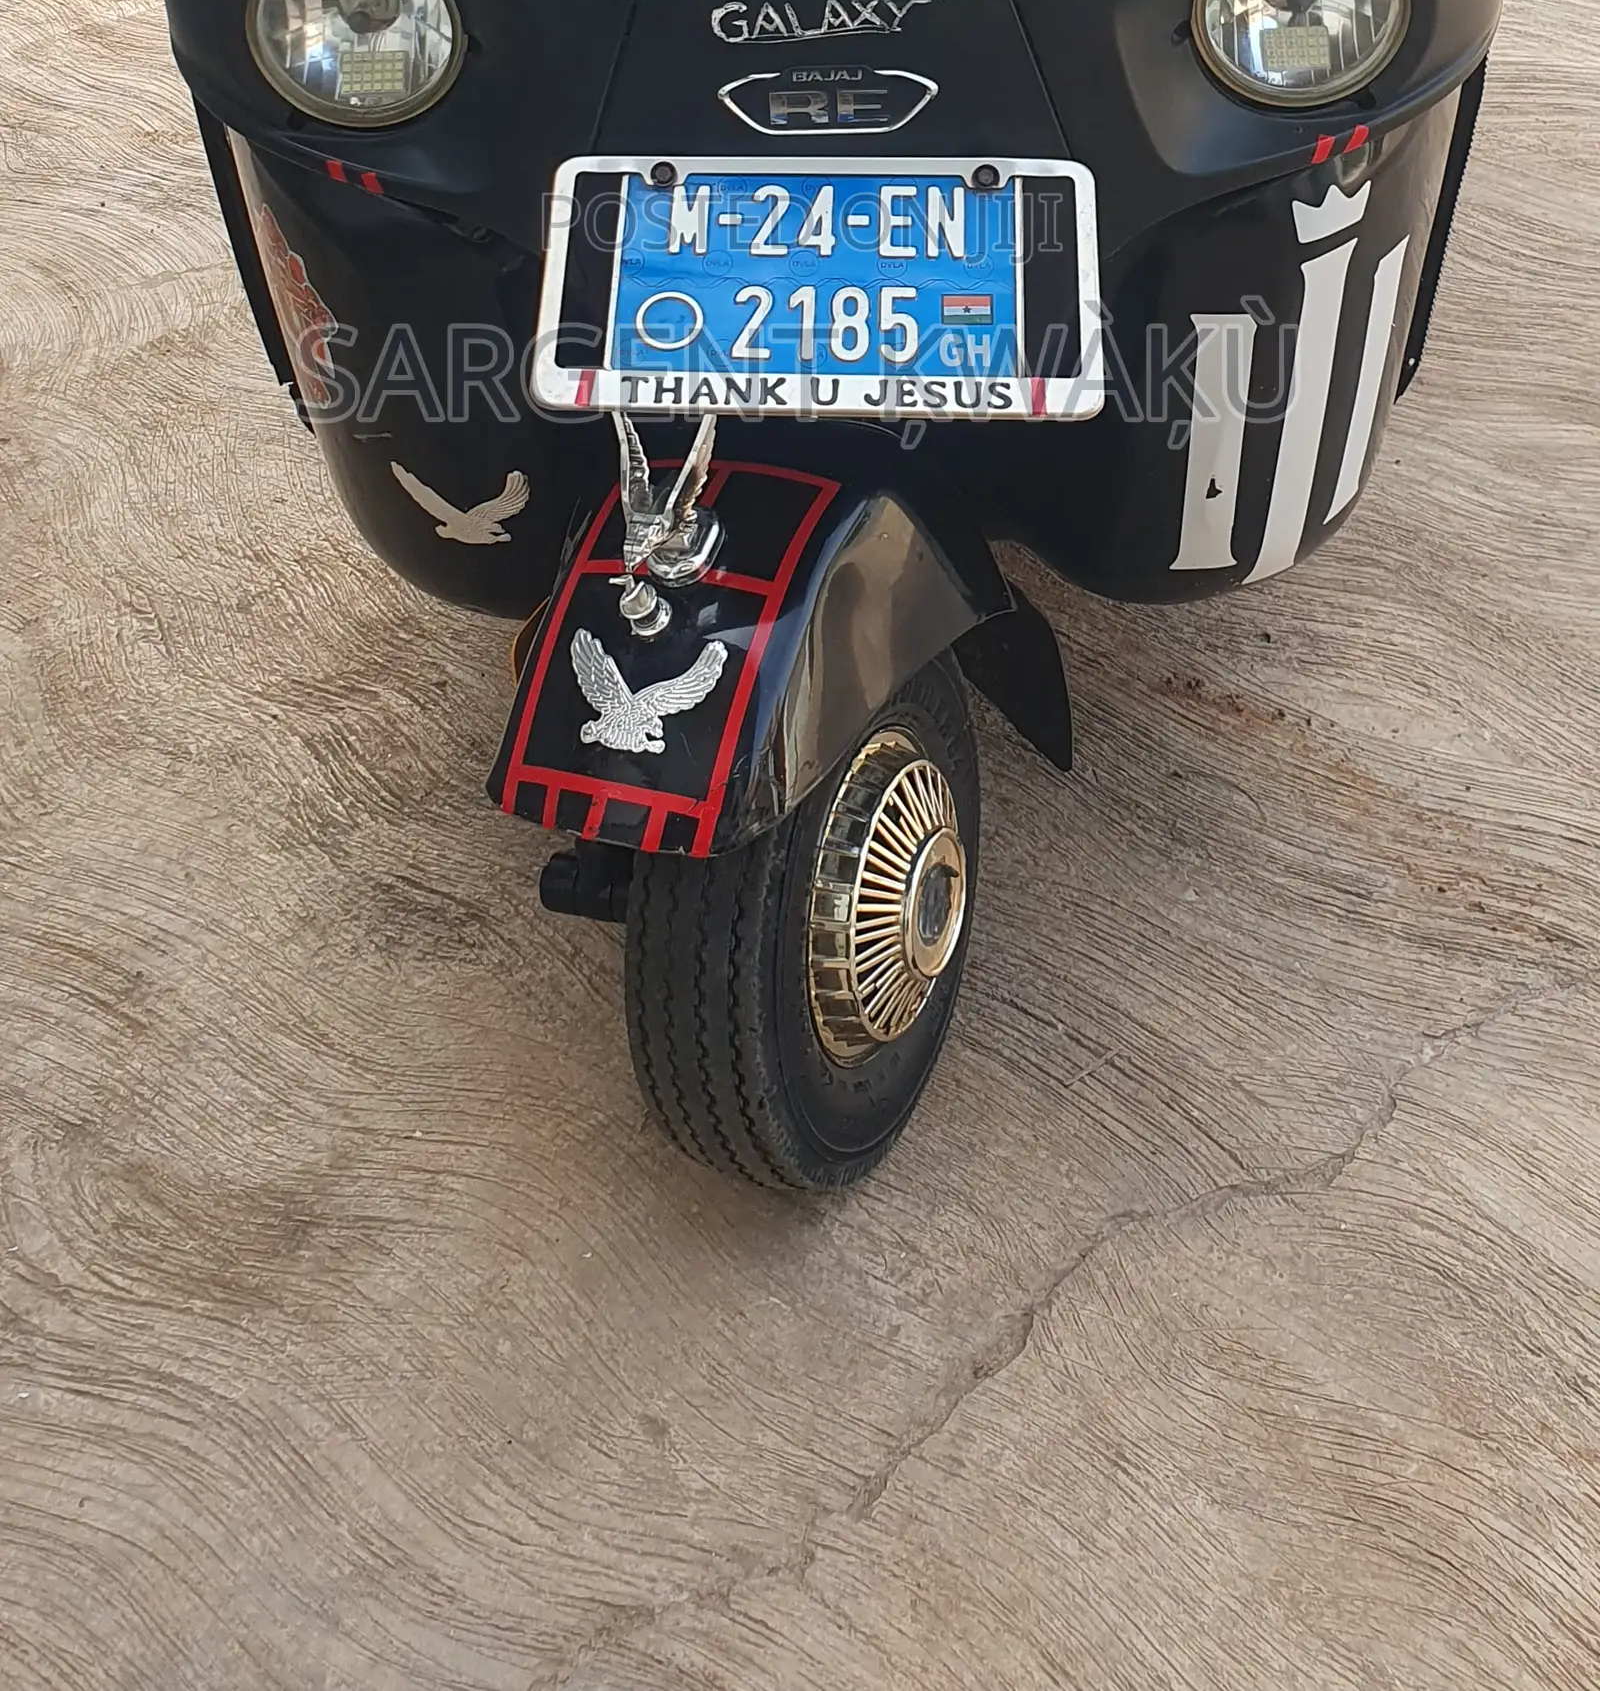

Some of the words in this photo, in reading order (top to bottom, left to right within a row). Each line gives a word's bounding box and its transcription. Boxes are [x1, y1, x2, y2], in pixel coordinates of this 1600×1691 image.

[792, 69, 862, 82] BAJAJ
[768, 88, 889, 125] RE
[668, 185, 965, 259] M-24-EN
[731, 284, 919, 363] 2185
[939, 333, 991, 367] GH
[621, 376, 788, 406] THANK
[810, 376, 840, 406] U
[864, 379, 1013, 409] JESUS
